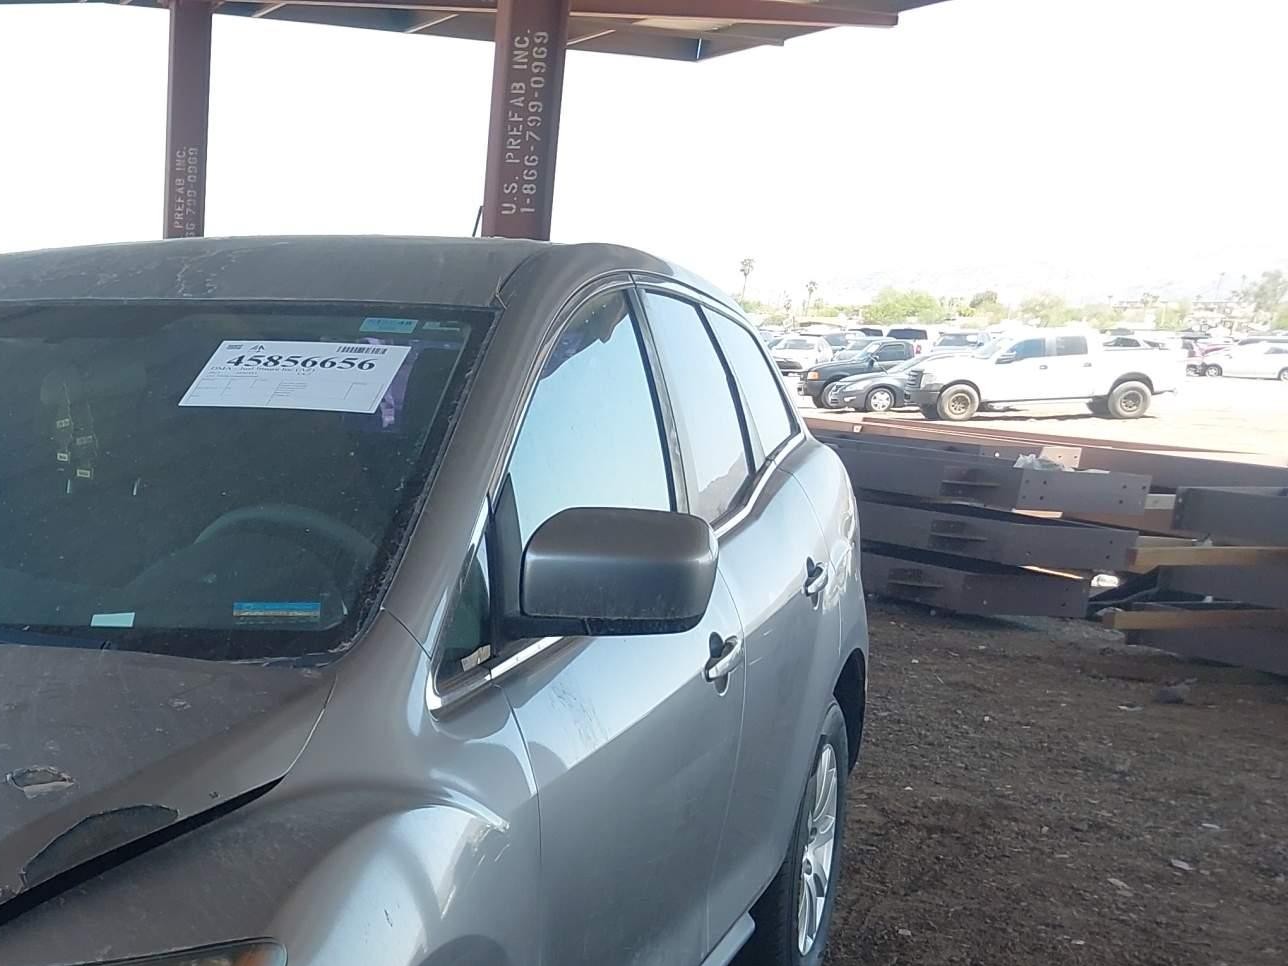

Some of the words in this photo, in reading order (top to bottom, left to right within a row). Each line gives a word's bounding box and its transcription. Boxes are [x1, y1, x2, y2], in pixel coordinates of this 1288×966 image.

[513, 29, 530, 69] INC.
[505, 82, 526, 163] PREFAB
[519, 31, 549, 214] 1-866-799-0969
[174, 178, 185, 229] PREFAB
[501, 176, 520, 215] U.S.
[226, 355, 378, 371] 45856656
